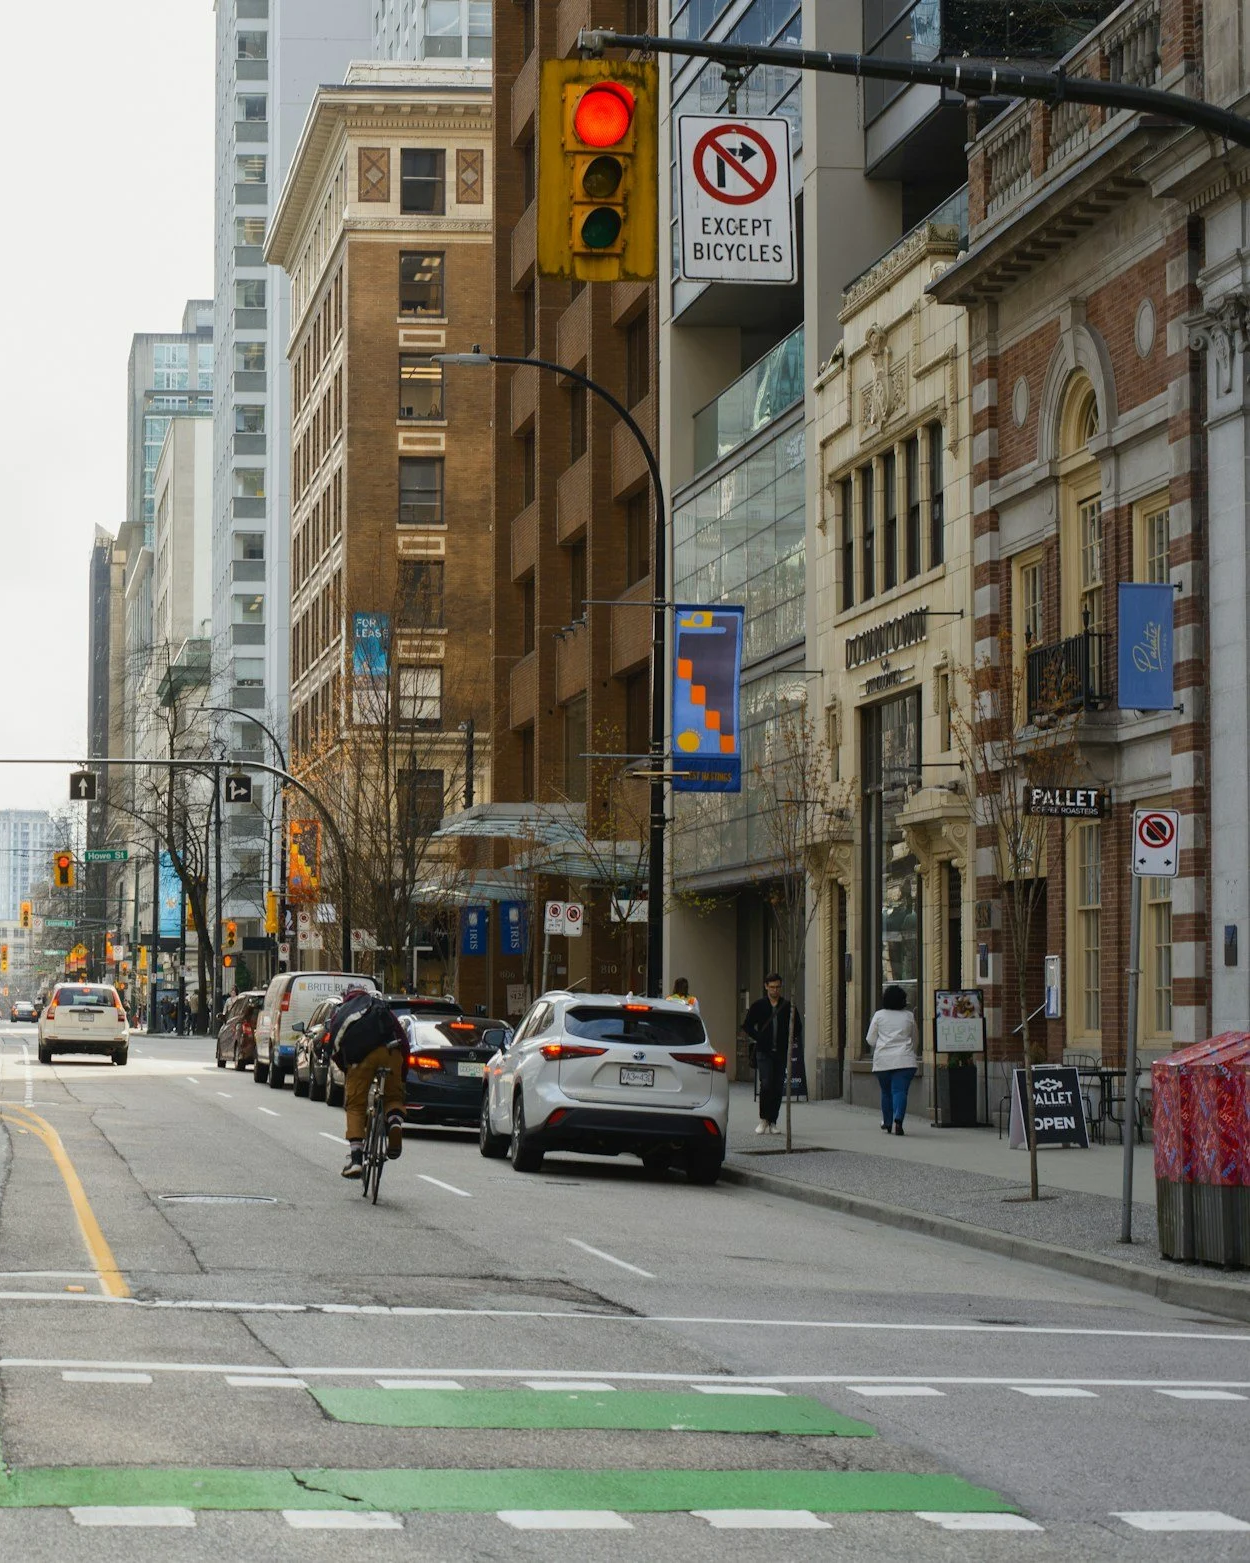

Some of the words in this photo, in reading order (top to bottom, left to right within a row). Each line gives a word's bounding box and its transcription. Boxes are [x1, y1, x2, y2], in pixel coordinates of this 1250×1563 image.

[702, 217, 772, 237] EXCEPT
[693, 242, 783, 263] BICYCLES
[356, 618, 377, 628] FOR
[356, 628, 389, 638] LEASE
[845, 605, 929, 670] DOWNTOWN
[1031, 788, 1098, 808] PALLET
[1060, 806, 1099, 816] ROASTERS
[87, 852, 111, 860] Howe
[114, 851, 125, 859] St
[469, 929, 478, 950] IRIS
[510, 926, 520, 948] IRIS
[307, 983, 332, 991] BRITE
[942, 1024, 977, 1034] HIGH
[943, 1033, 977, 1043] TEA
[1034, 1116, 1076, 1131] OPEN
